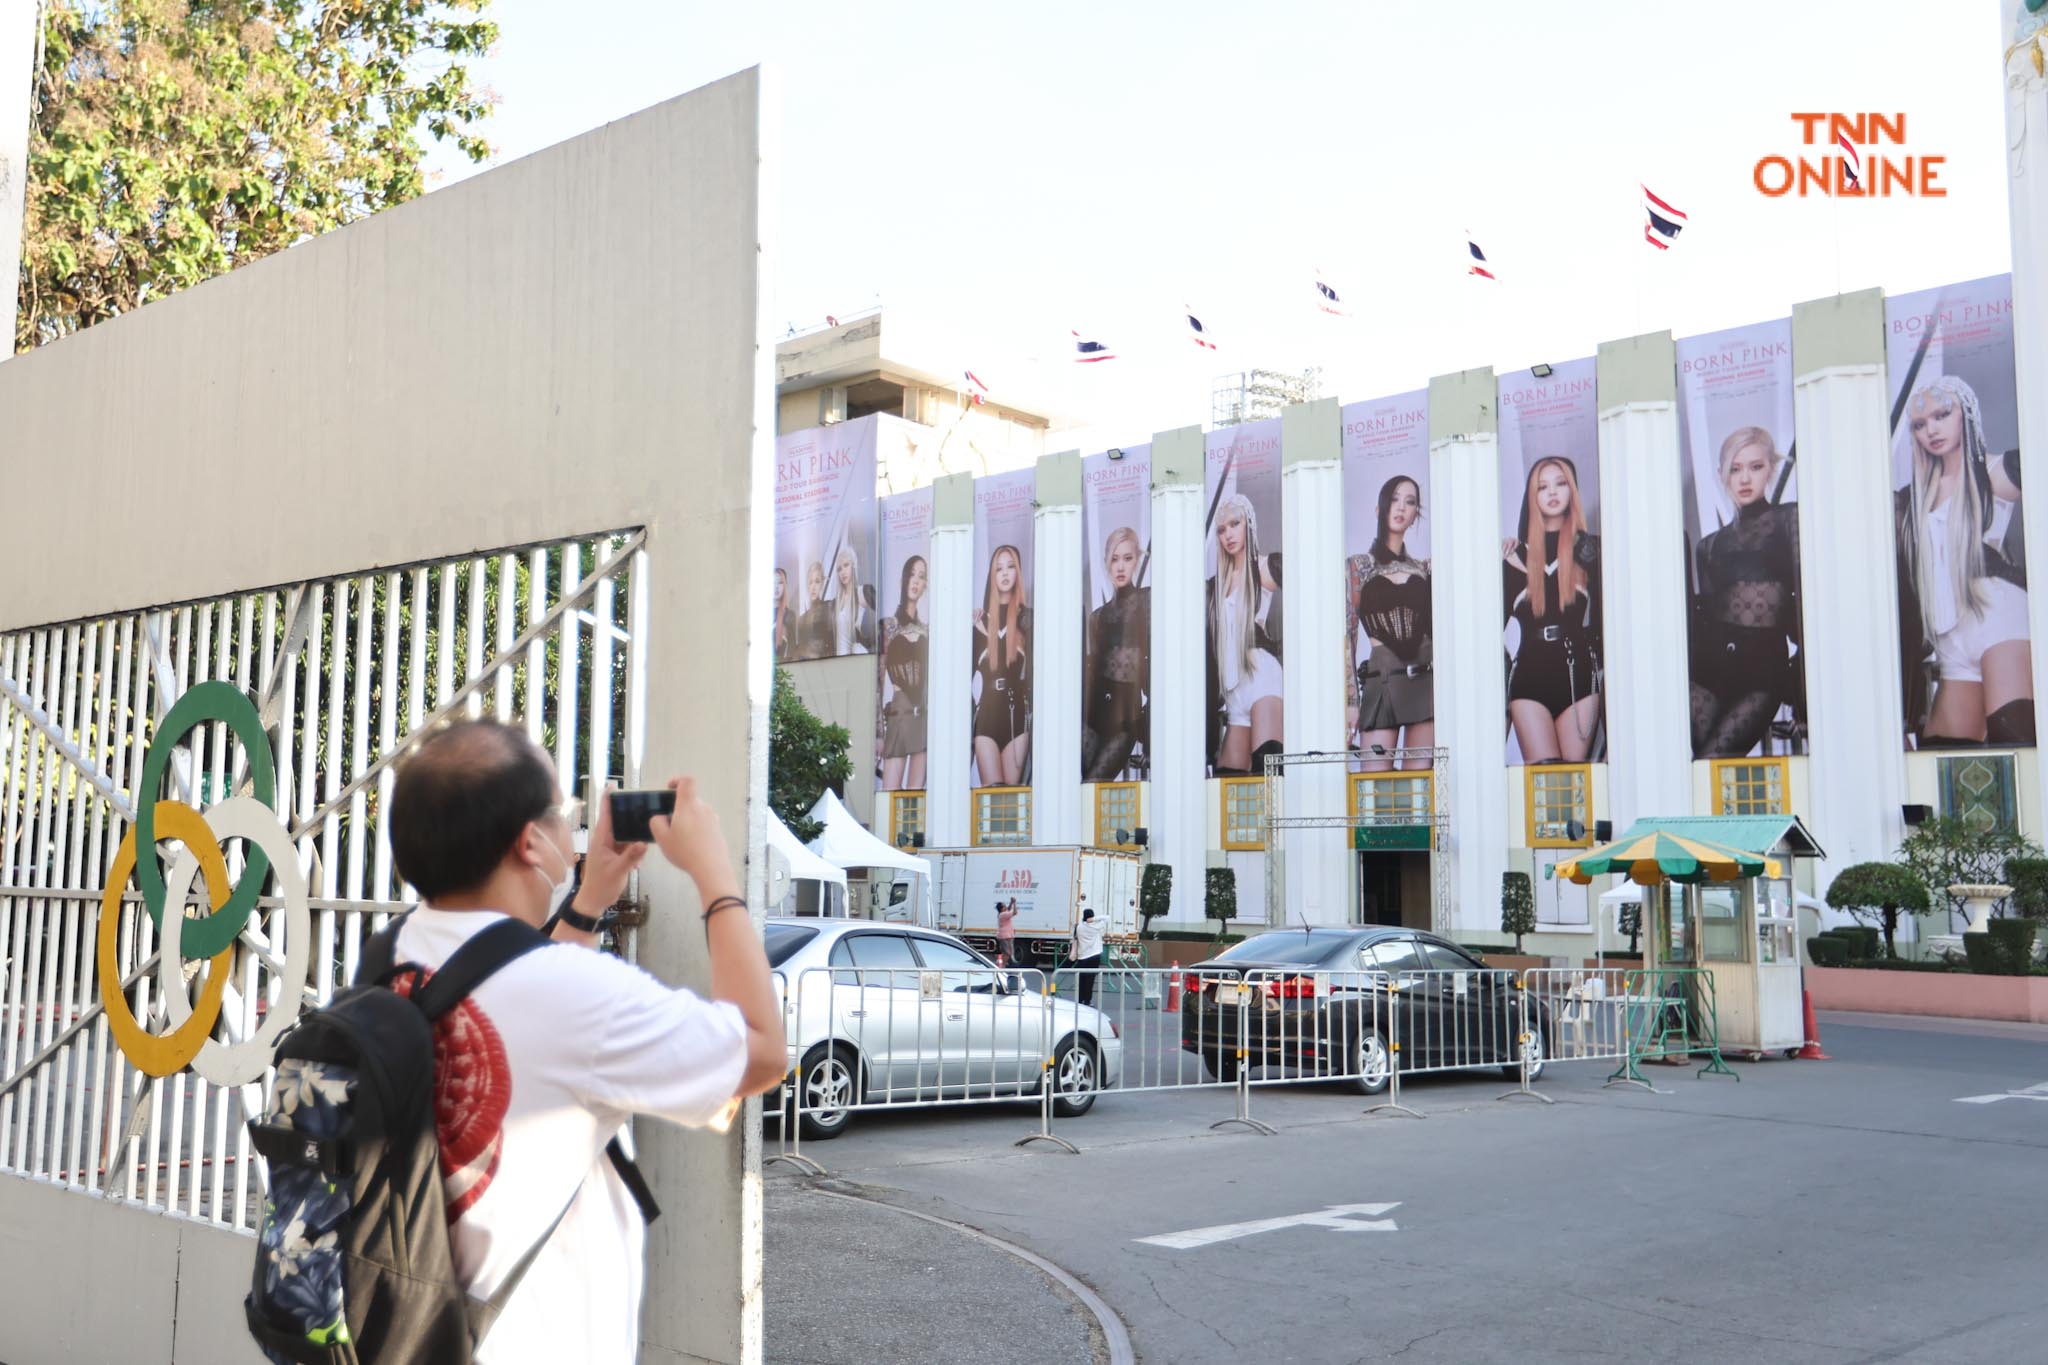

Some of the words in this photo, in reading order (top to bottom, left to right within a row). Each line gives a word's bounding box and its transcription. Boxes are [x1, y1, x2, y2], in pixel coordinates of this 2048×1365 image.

[1893, 310, 1953, 334] BORN
[1964, 298, 2013, 321] PINK
[1683, 352, 1734, 373] BORN
[1743, 342, 1787, 362] PINK
[1503, 387, 1547, 406] BORN
[1554, 378, 1592, 396] PINK
[1347, 417, 1385, 436] BORN
[1391, 409, 1425, 426] PINK
[777, 460, 801, 482] RN
[810, 447, 852, 475] PINK
[1086, 468, 1117, 483] BORN
